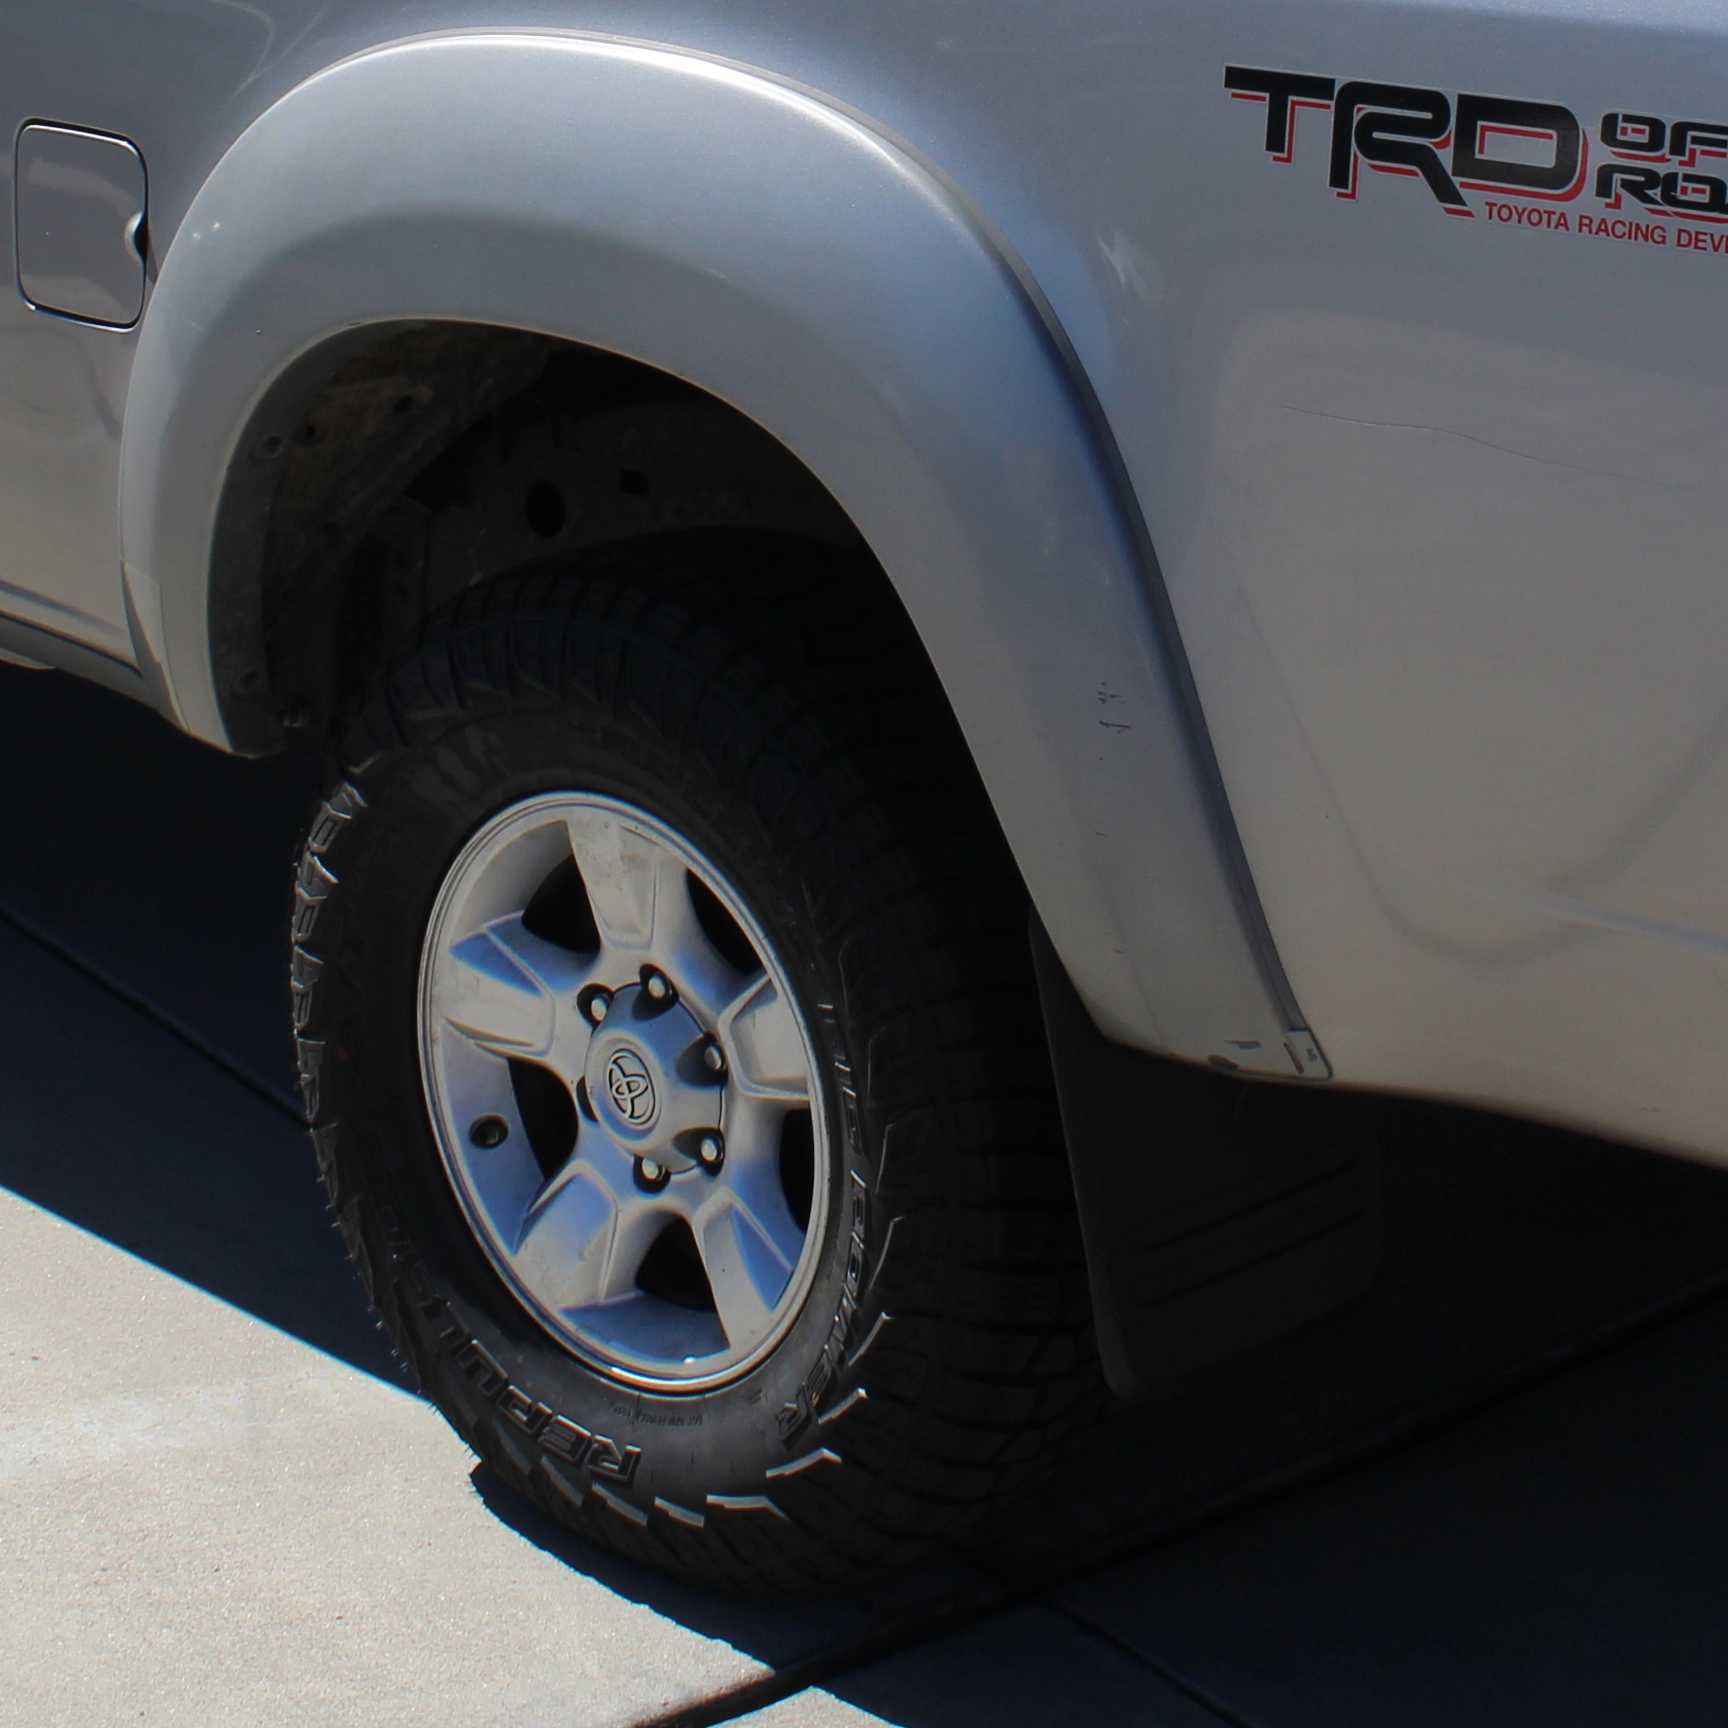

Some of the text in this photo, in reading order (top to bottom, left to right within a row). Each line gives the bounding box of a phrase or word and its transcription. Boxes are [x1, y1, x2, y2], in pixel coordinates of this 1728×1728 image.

[1223, 63, 1590, 218] TRD
[1484, 200, 1571, 233] TOYOTA
[1577, 214, 1668, 248] RACING
